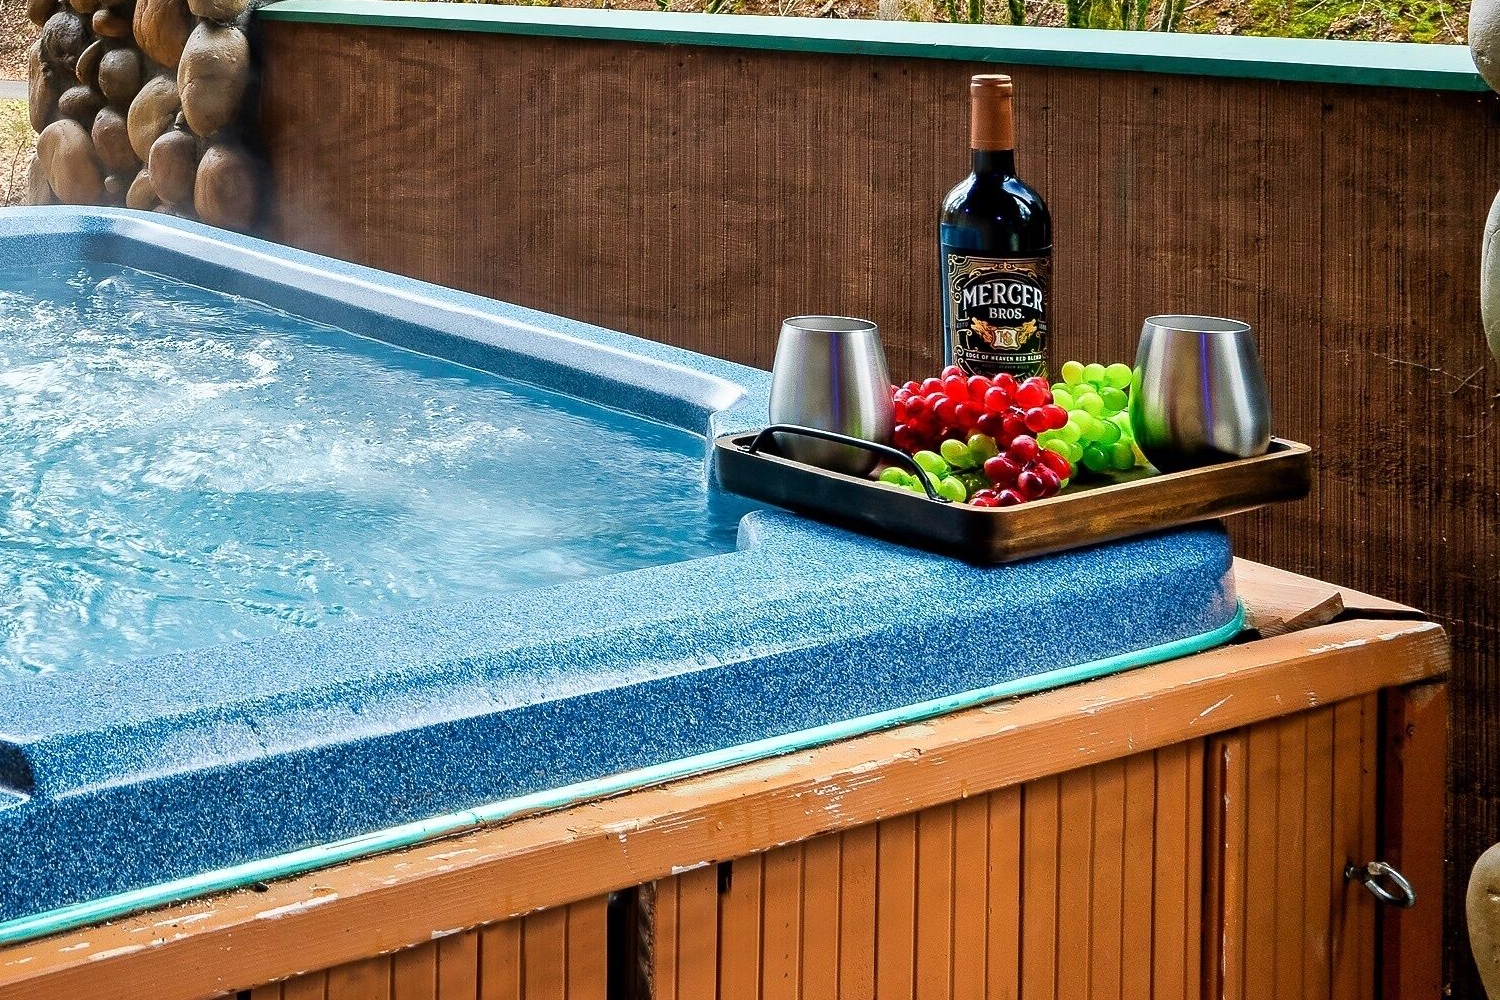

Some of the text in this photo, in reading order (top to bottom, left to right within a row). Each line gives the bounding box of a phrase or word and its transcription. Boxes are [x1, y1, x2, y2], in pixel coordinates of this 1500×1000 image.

[963, 282, 1043, 313] MERCER
[989, 307, 1026, 320] BROS.
[965, 352, 980, 360] EDGE
